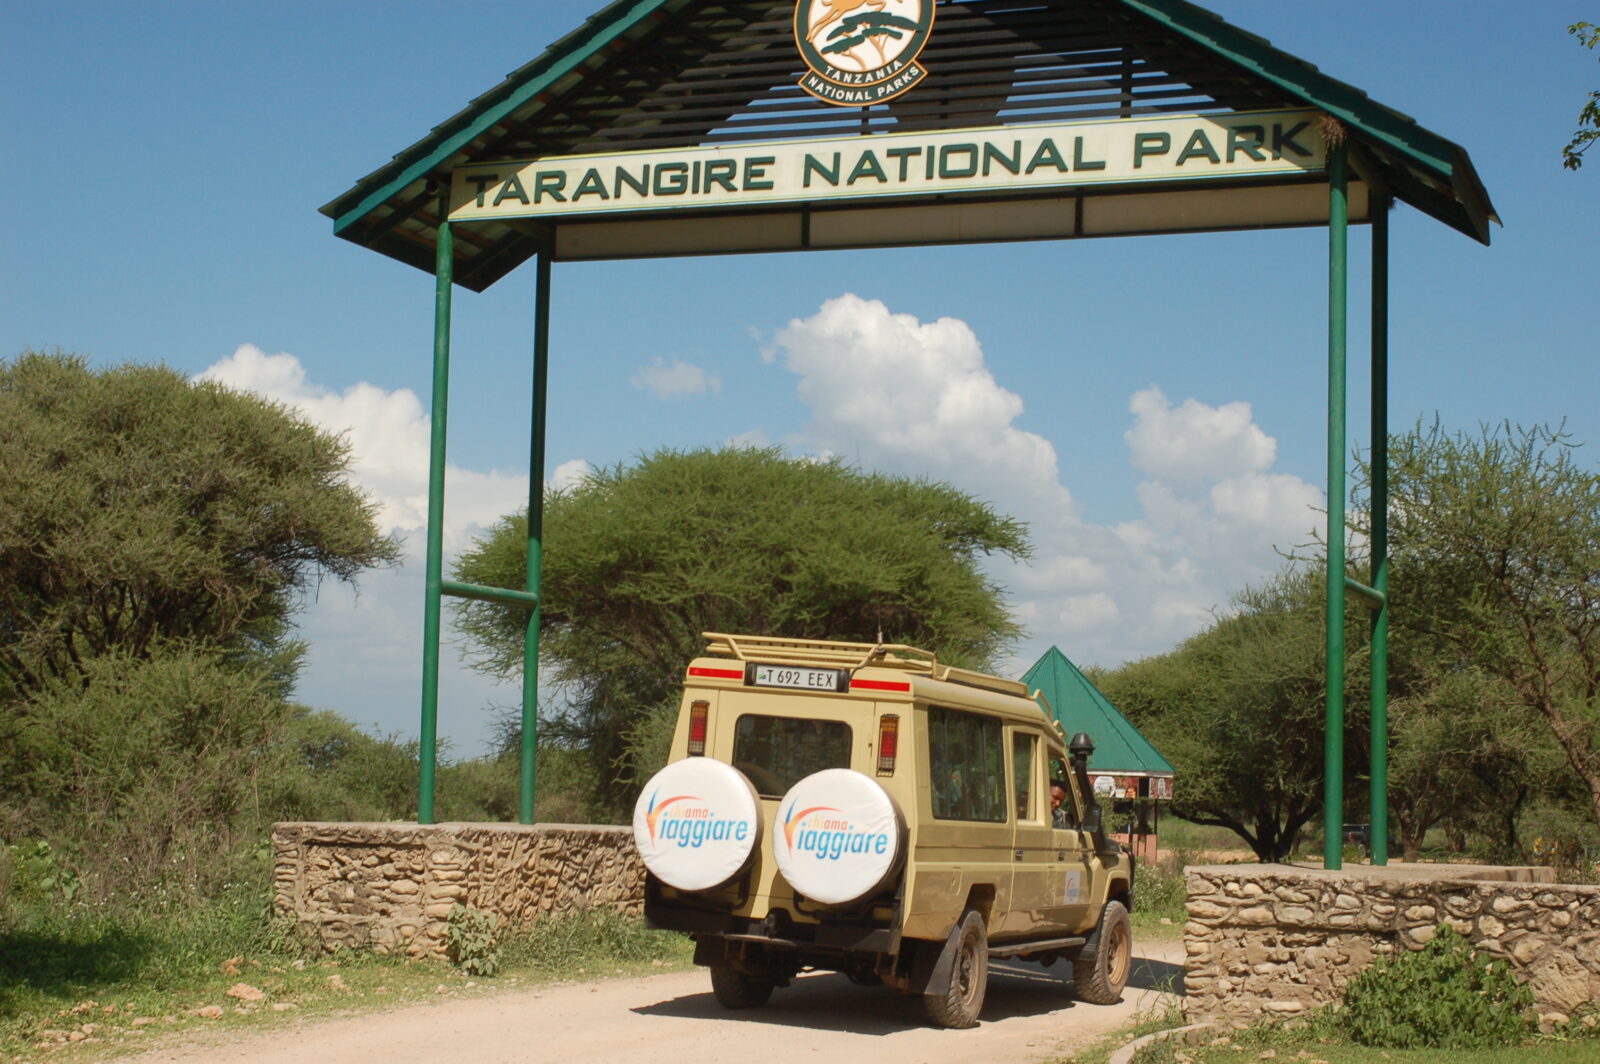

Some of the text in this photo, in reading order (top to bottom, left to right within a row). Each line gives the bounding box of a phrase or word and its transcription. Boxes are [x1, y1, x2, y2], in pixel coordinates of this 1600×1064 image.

[808, 65, 920, 101] NATIONAL PARKS
[824, 60, 903, 84] TANZANIA
[465, 121, 1313, 208] TARANGIRE NATIONAL PARK
[767, 669, 833, 687] T 692 EEX
